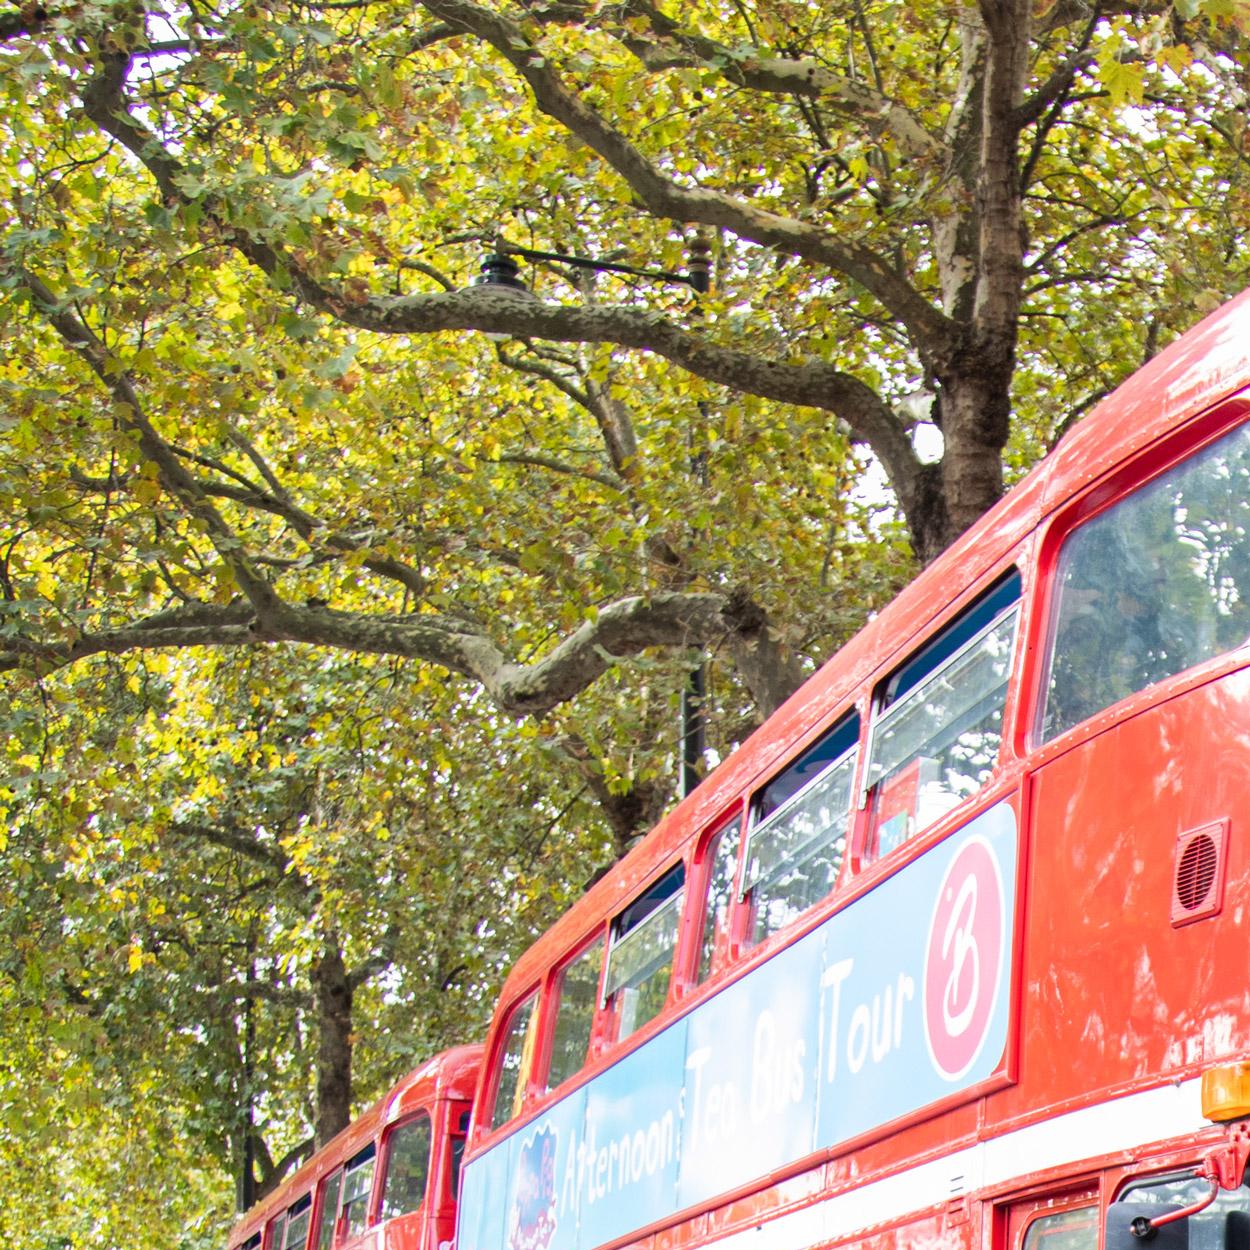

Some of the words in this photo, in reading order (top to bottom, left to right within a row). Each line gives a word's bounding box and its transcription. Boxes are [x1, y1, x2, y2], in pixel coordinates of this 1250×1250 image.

[561, 1109, 673, 1217] Afternoon
[686, 1046, 738, 1151] Tea
[752, 1009, 806, 1125] Bus
[822, 958, 915, 1083] Tour
